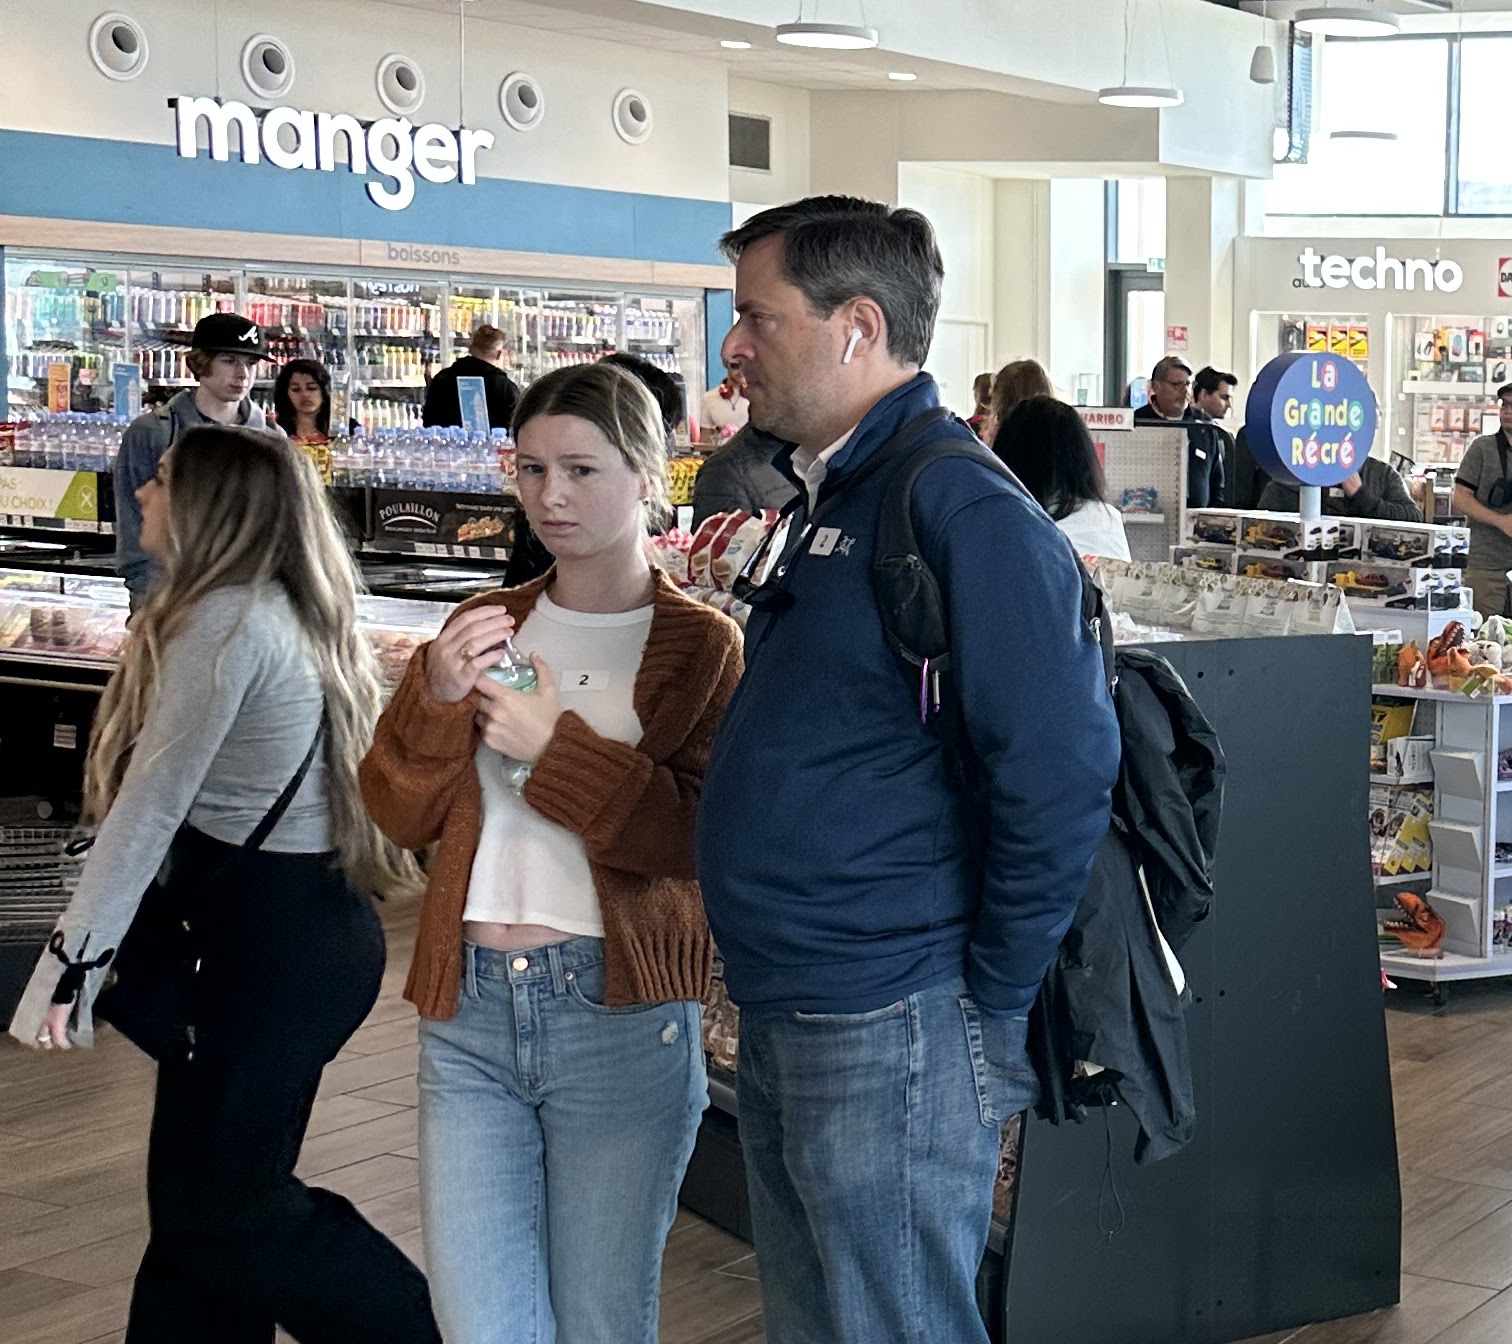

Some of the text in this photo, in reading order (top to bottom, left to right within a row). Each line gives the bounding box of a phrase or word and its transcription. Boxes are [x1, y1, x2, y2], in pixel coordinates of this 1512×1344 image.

[178, 96, 495, 211] manger
[387, 243, 461, 266] boissons
[1299, 246, 1463, 293] techno
[1311, 360, 1337, 389] La
[1284, 398, 1362, 429] Grande
[1291, 430, 1354, 466] Récré
[379, 502, 441, 523] POULAILLON
[579, 674, 589, 686] 2
